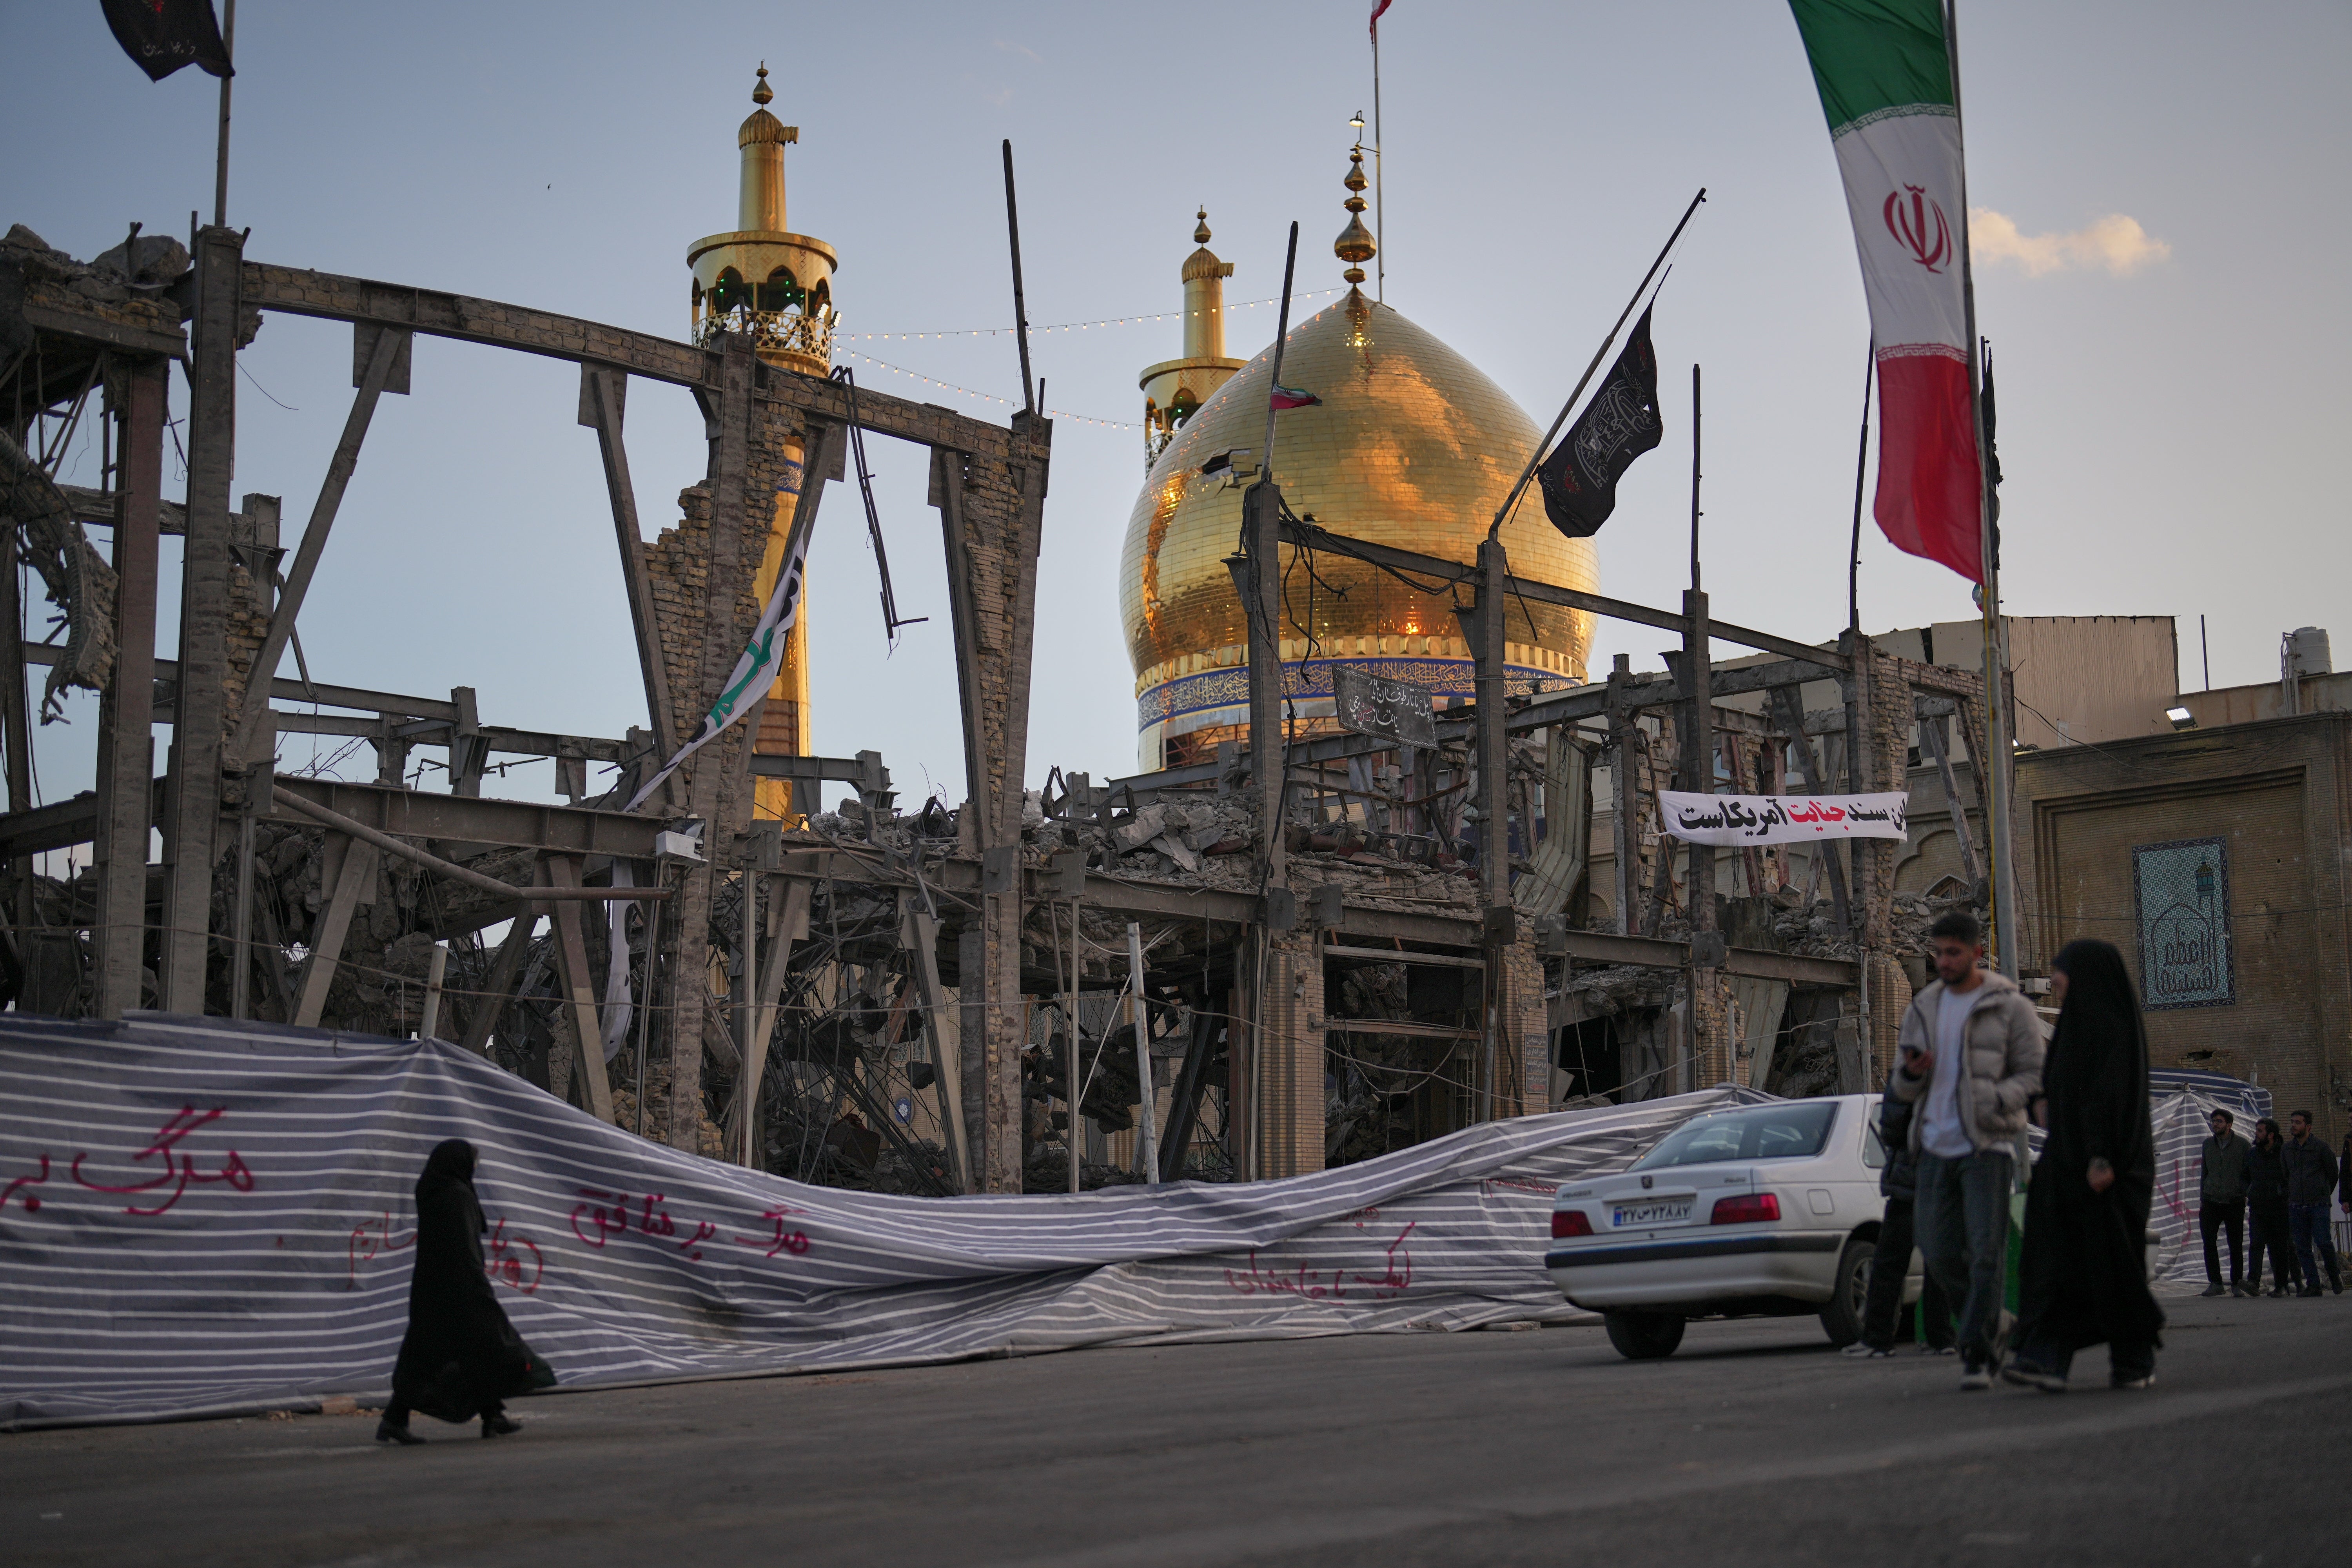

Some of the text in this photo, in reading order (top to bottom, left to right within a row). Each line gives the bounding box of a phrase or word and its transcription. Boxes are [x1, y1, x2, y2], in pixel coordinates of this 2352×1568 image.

[1678, 798, 1906, 836] این سند جنایت آمریکاست
[1526, 1036, 1538, 1045] همایش
[72, 1104, 254, 1216] مرگ
[679, 1221, 716, 1261] بر
[735, 1204, 811, 1258] مرگ
